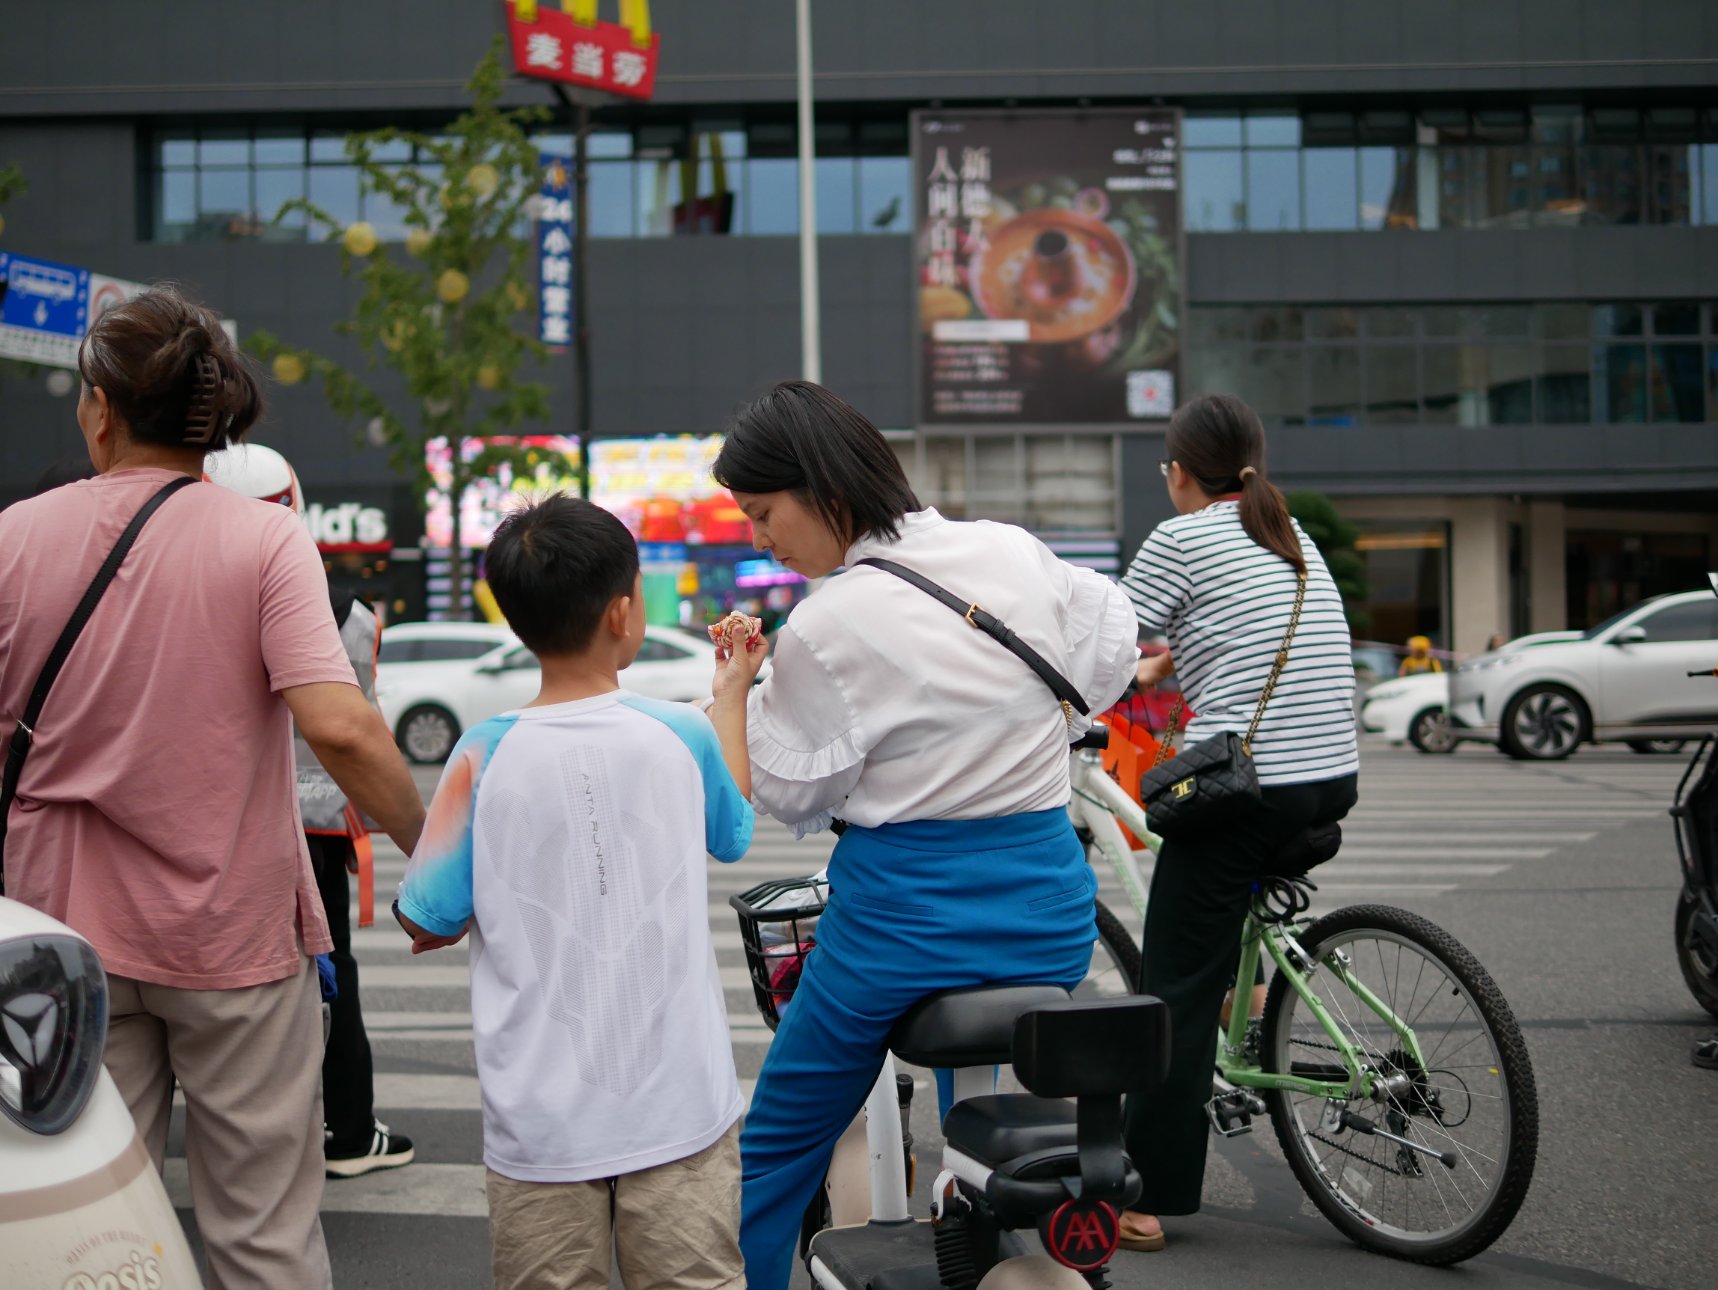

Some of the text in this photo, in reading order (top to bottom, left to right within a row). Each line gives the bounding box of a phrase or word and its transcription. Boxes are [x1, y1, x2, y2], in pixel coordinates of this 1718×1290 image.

[526, 33, 647, 86] 麦当劳
[580, 773, 607, 896] ANTA RUNNING
